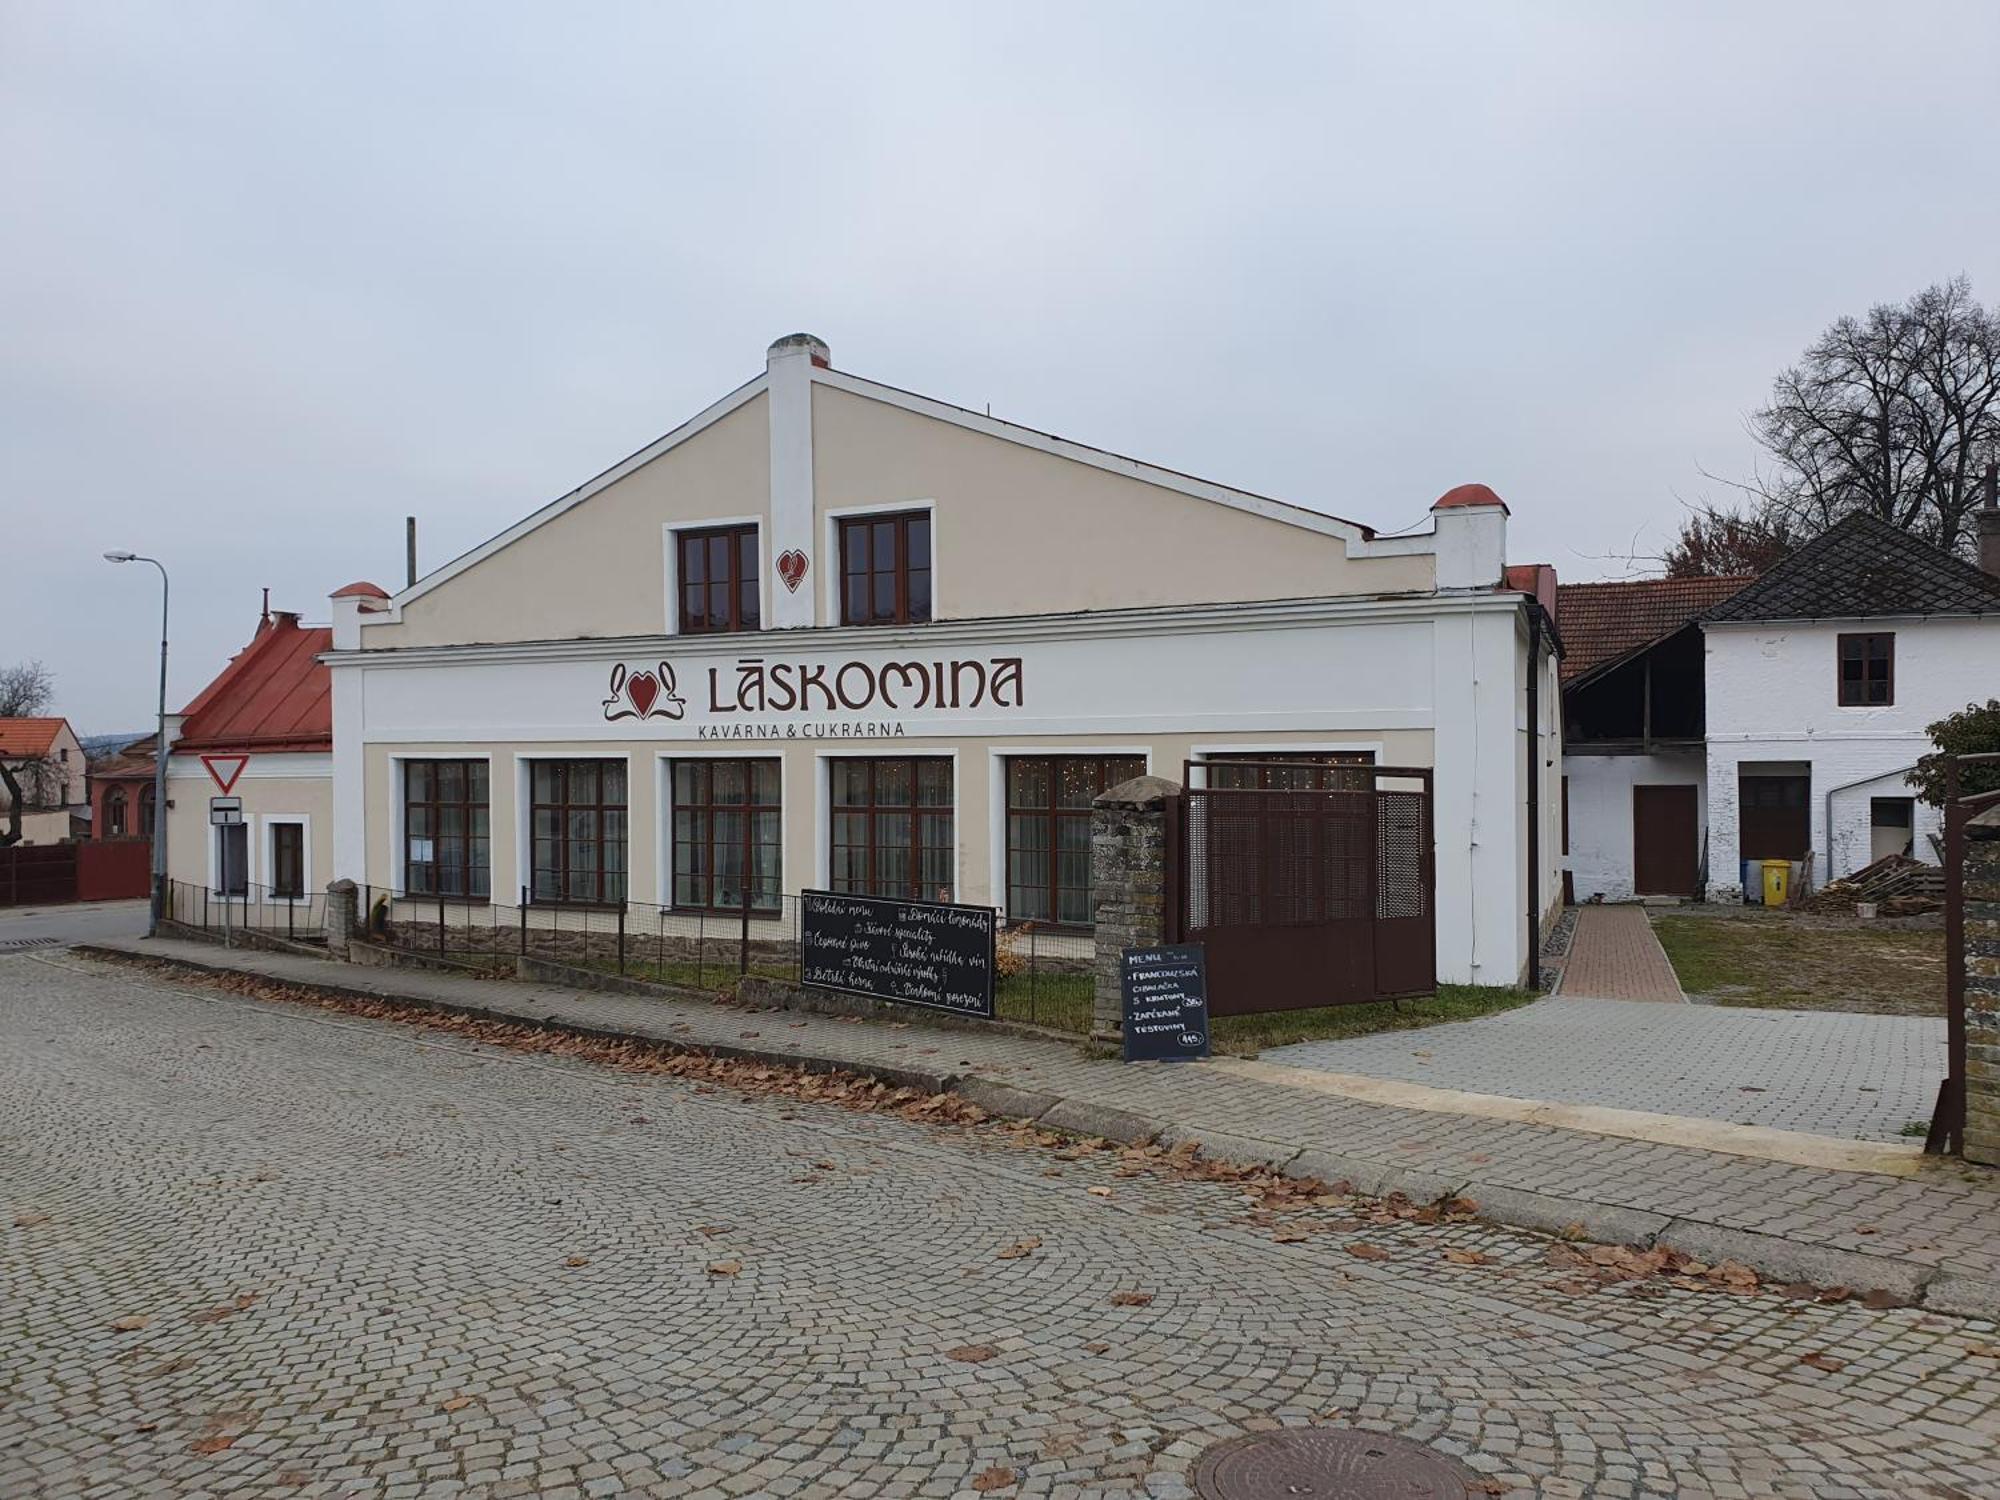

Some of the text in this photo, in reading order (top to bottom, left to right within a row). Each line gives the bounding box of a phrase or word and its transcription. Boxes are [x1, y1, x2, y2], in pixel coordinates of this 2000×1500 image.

[699, 722, 905, 739] KAVÁRNA & CUKRÁRNA
[1129, 953, 1162, 964] MENU
